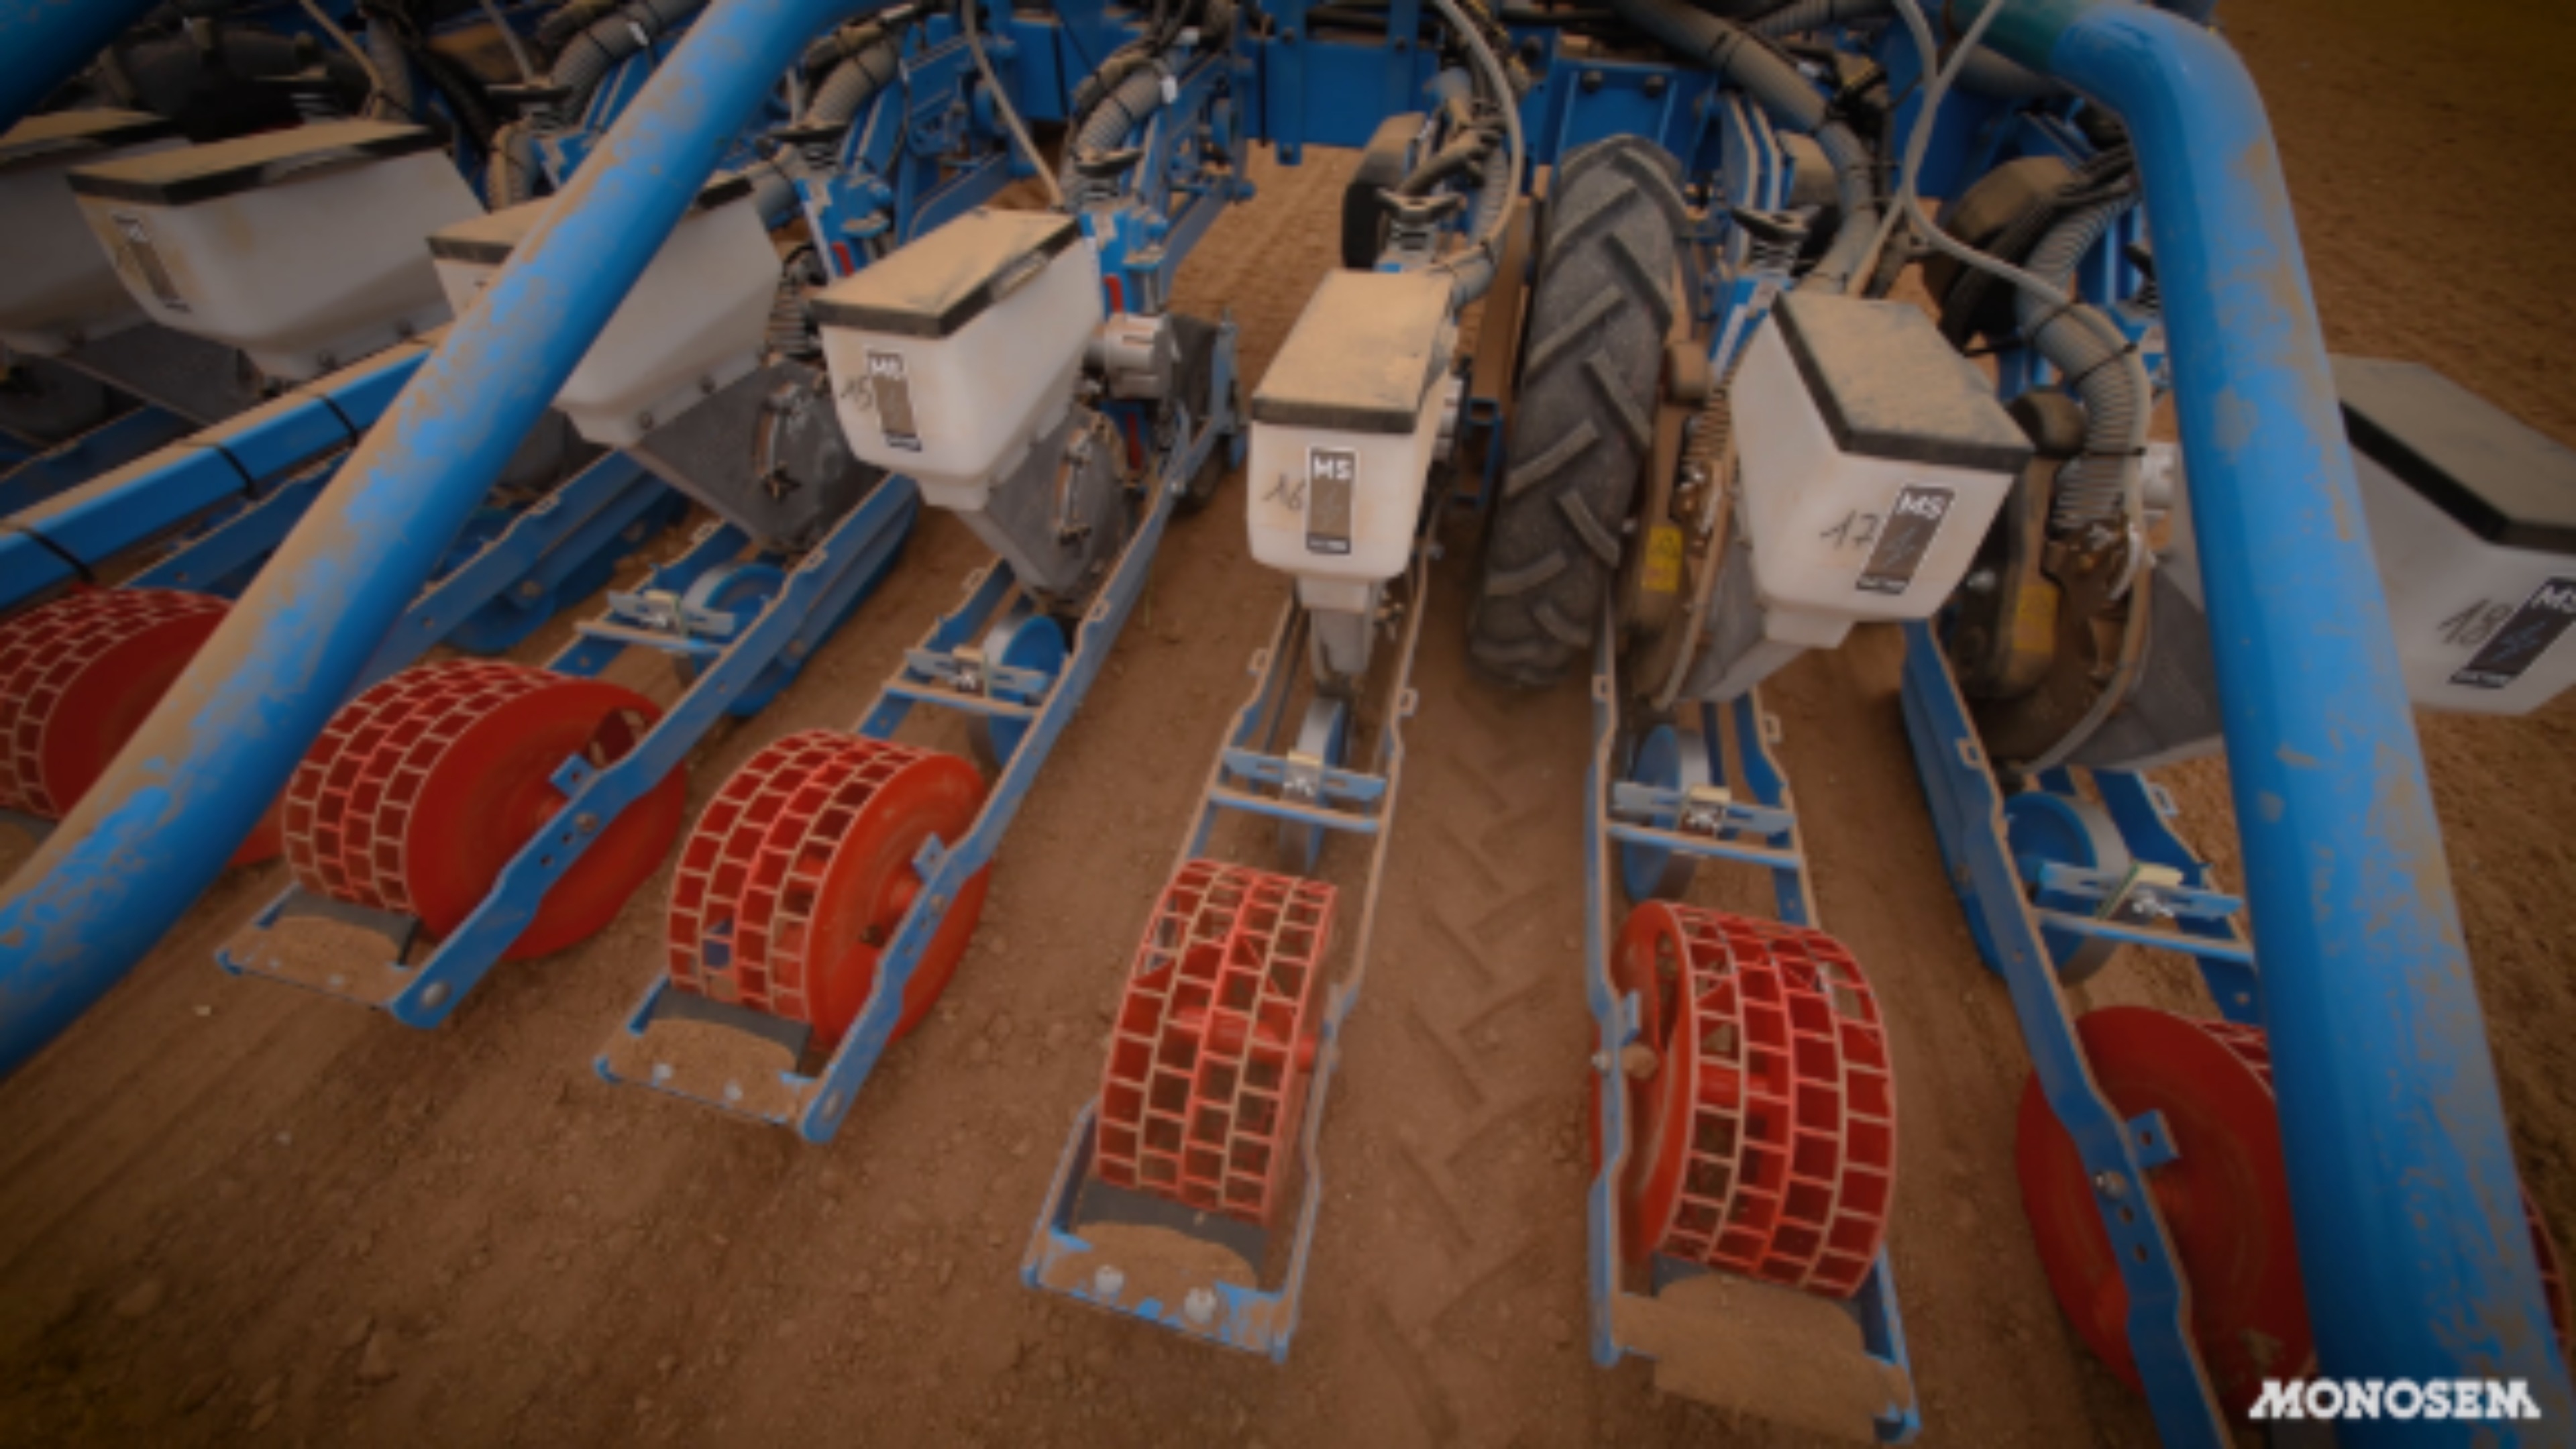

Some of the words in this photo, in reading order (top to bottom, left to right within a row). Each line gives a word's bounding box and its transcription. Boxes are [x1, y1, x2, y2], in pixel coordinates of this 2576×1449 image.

[1313, 455, 1352, 480] MS
[1263, 472, 1306, 511] 16
[1894, 491, 1945, 520] MS
[1819, 509, 1879, 549] 17
[2437, 598, 2514, 647] 18
